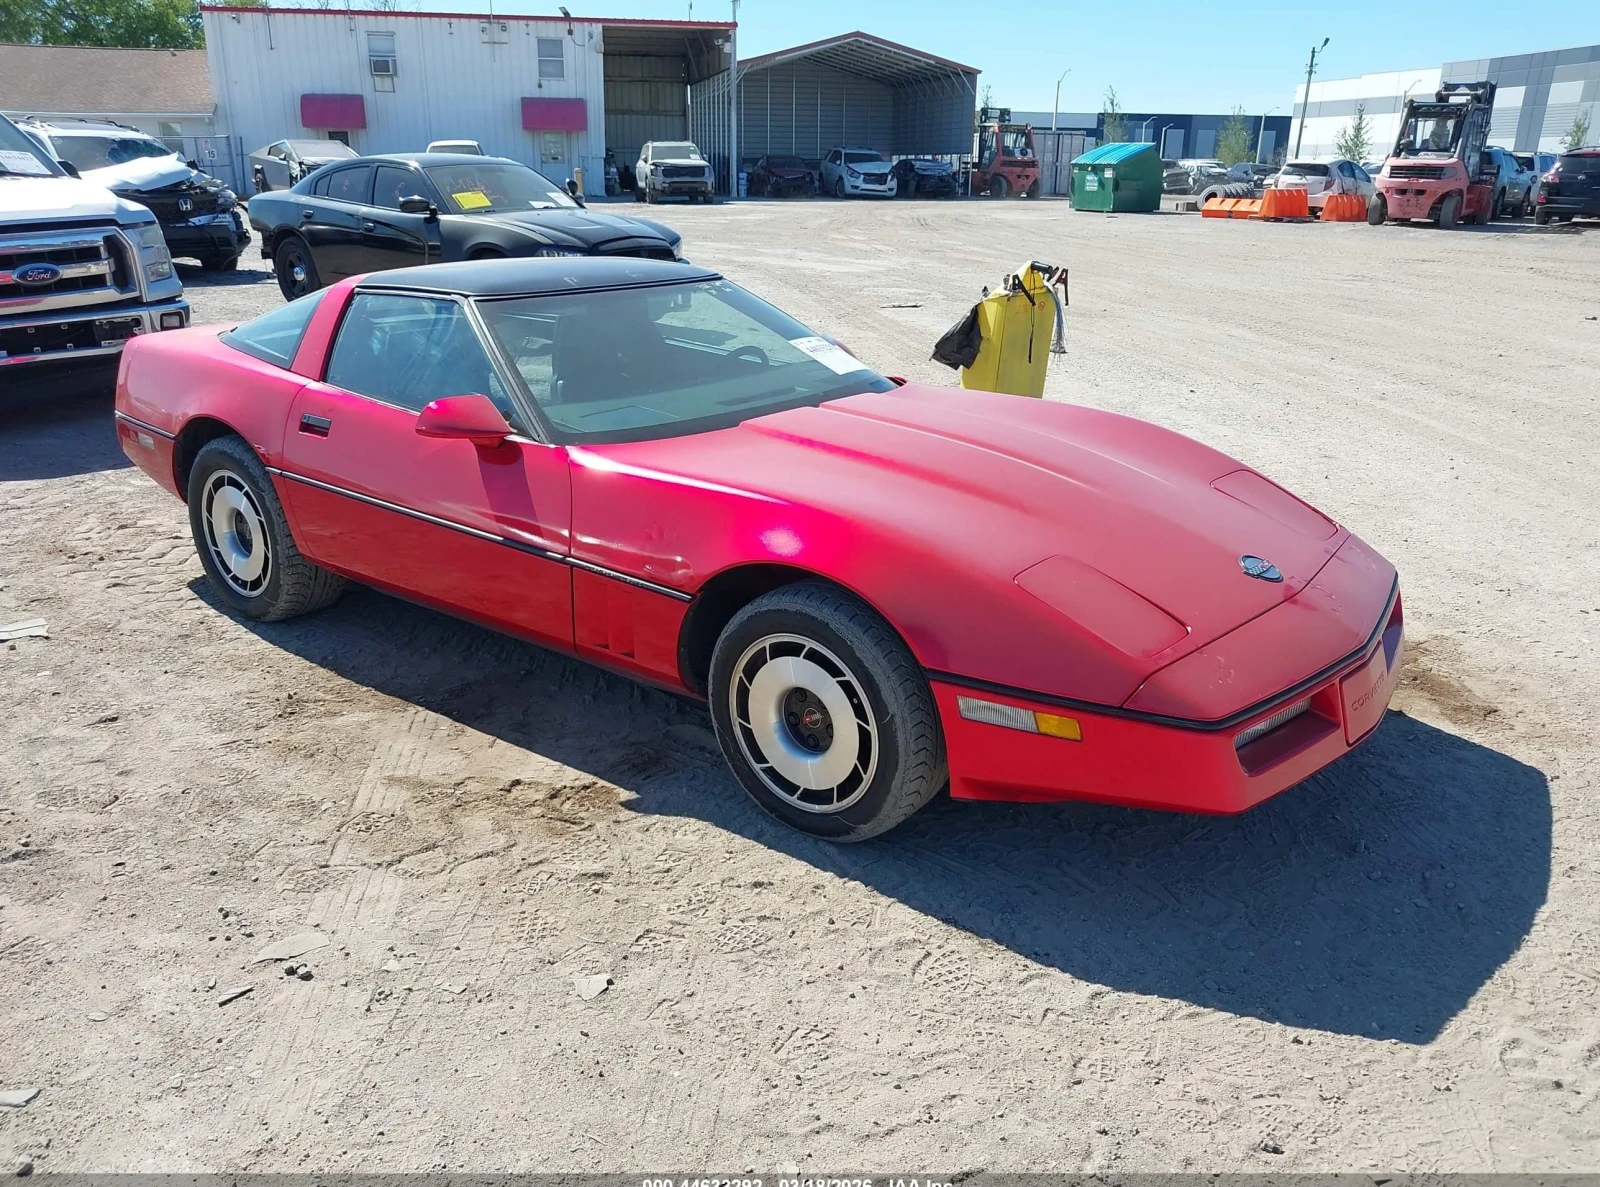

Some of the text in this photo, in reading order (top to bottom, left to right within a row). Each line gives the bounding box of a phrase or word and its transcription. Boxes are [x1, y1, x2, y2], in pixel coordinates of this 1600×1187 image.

[208, 150, 216, 159] 15
[27, 269, 51, 281] Ford
[1351, 670, 1385, 712] CORVETTE
